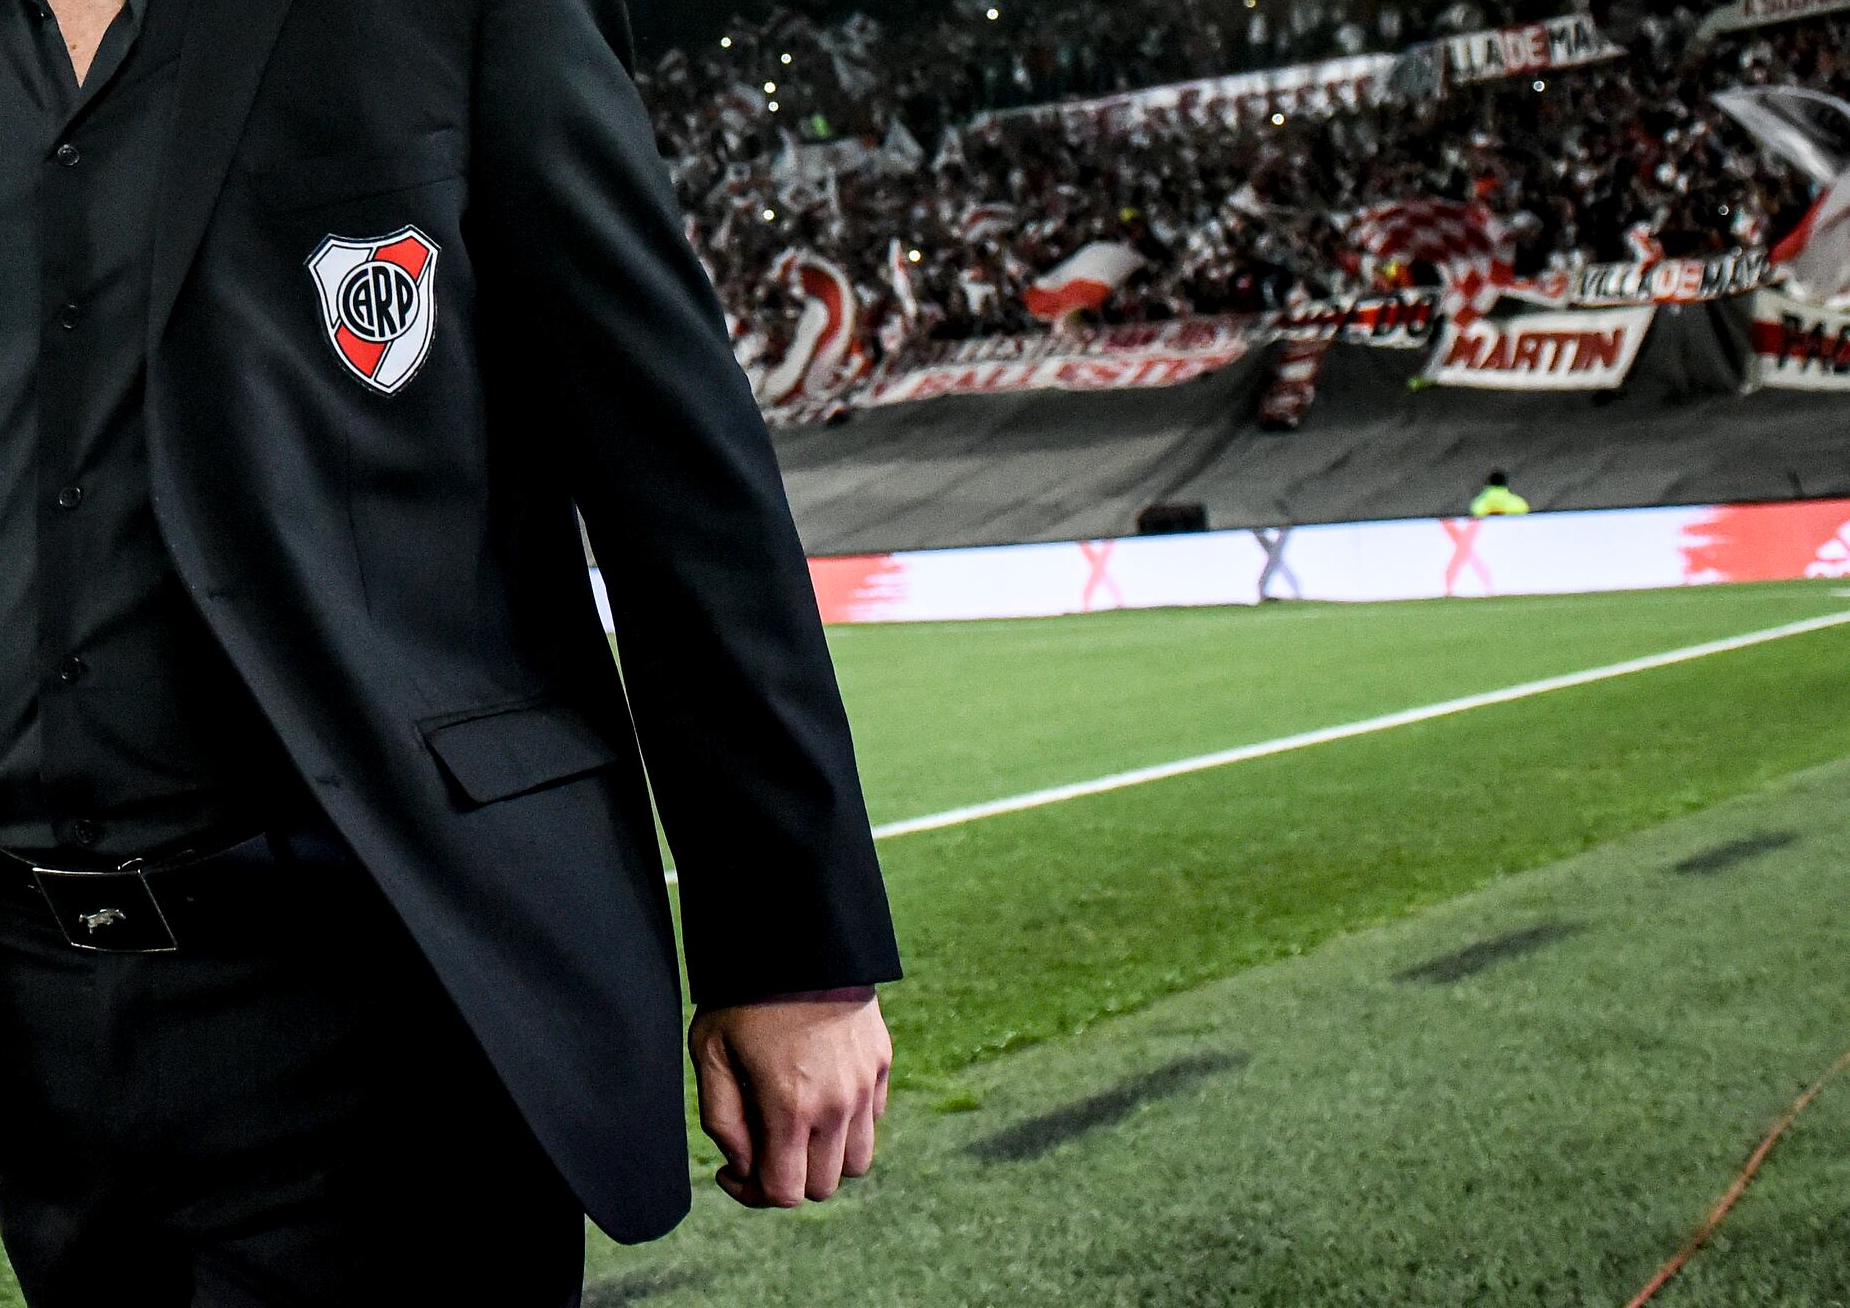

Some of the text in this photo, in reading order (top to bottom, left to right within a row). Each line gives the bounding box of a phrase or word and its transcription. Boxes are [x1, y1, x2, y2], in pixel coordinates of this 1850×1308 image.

[342, 265, 414, 338] CARP
[1650, 259, 1702, 298] DE
[1444, 325, 1625, 373] MARTIN
